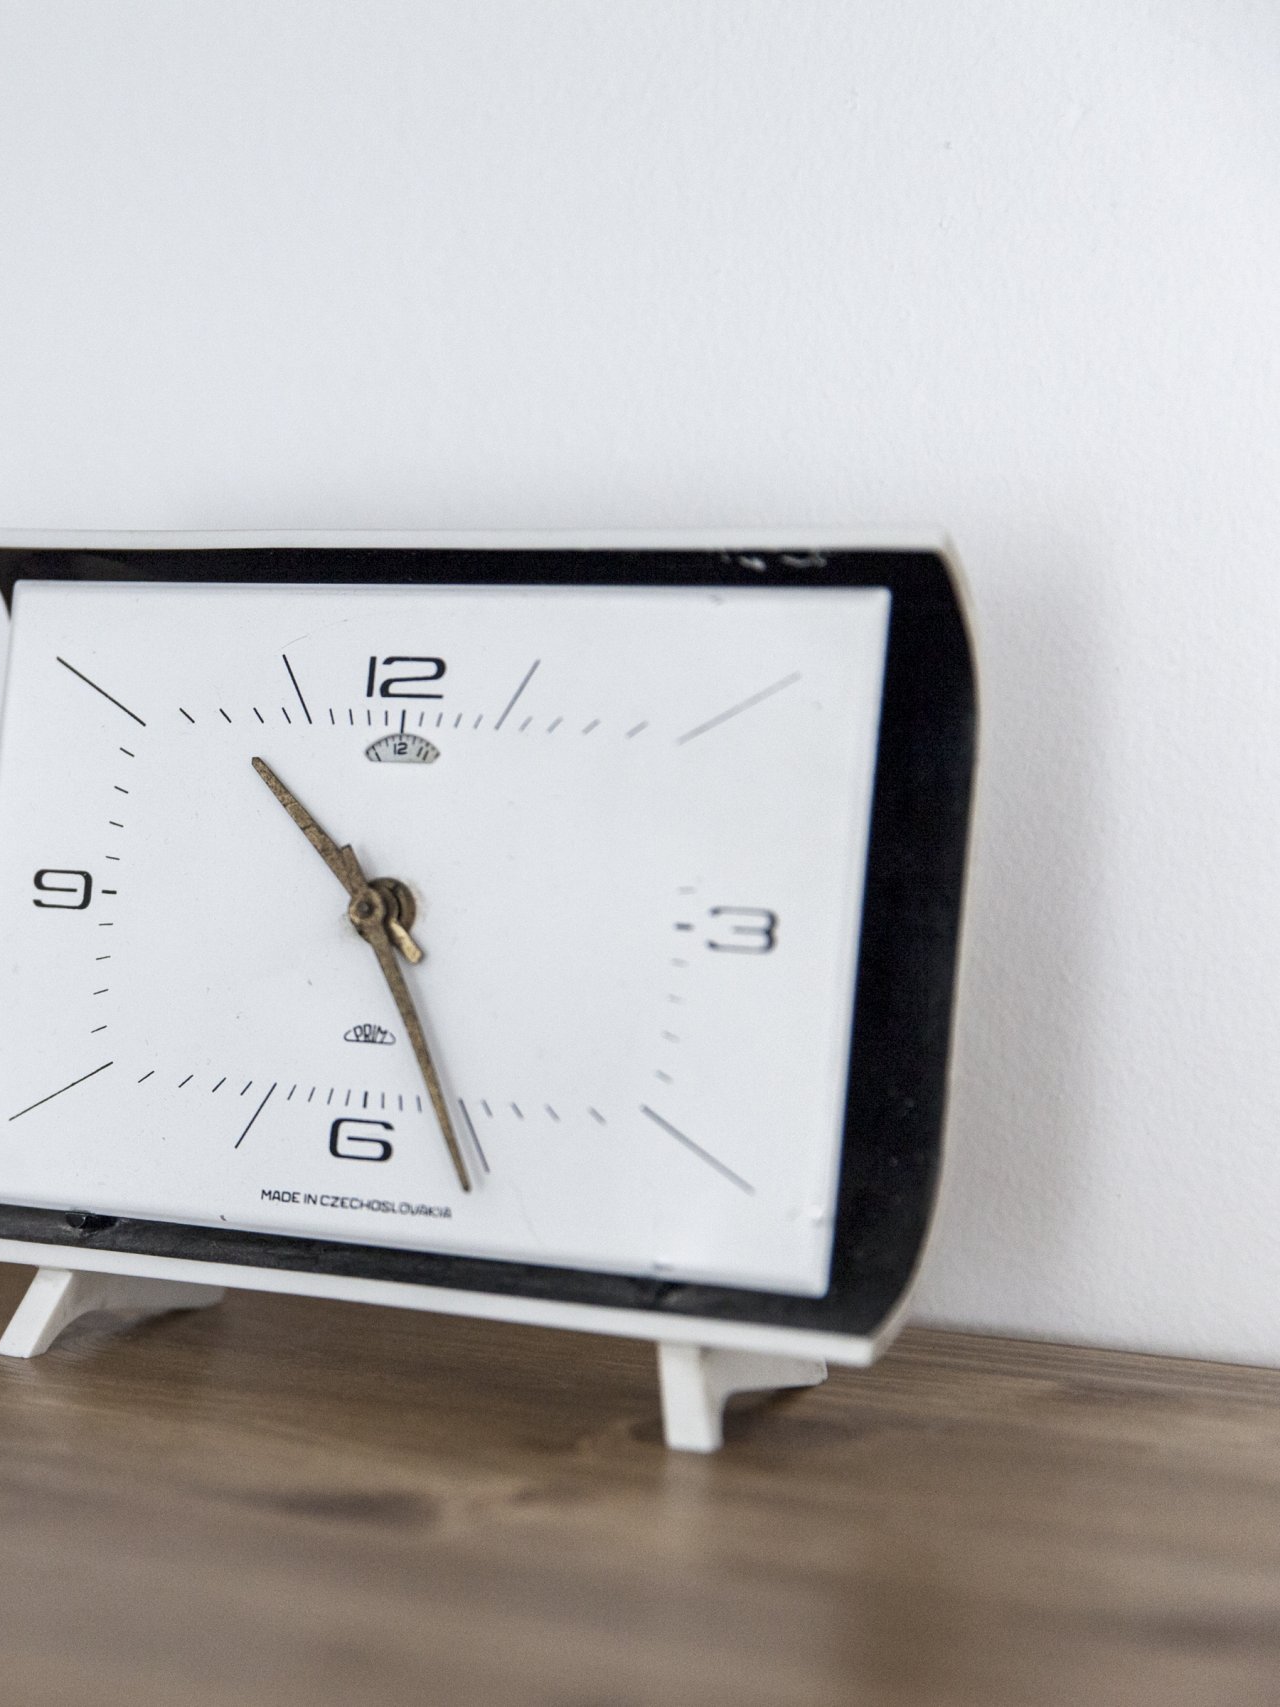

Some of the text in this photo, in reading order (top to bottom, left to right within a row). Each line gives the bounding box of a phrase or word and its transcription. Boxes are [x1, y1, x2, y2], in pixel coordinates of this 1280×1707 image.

[366, 656, 447, 699] 12
[393, 742, 408, 755] 12
[33, 869, 93, 910] 9
[707, 905, 780, 955] 3
[329, 1117, 395, 1162] 6
[261, 1189, 453, 1219] MADE IN CZECHOSLOVAKIA
